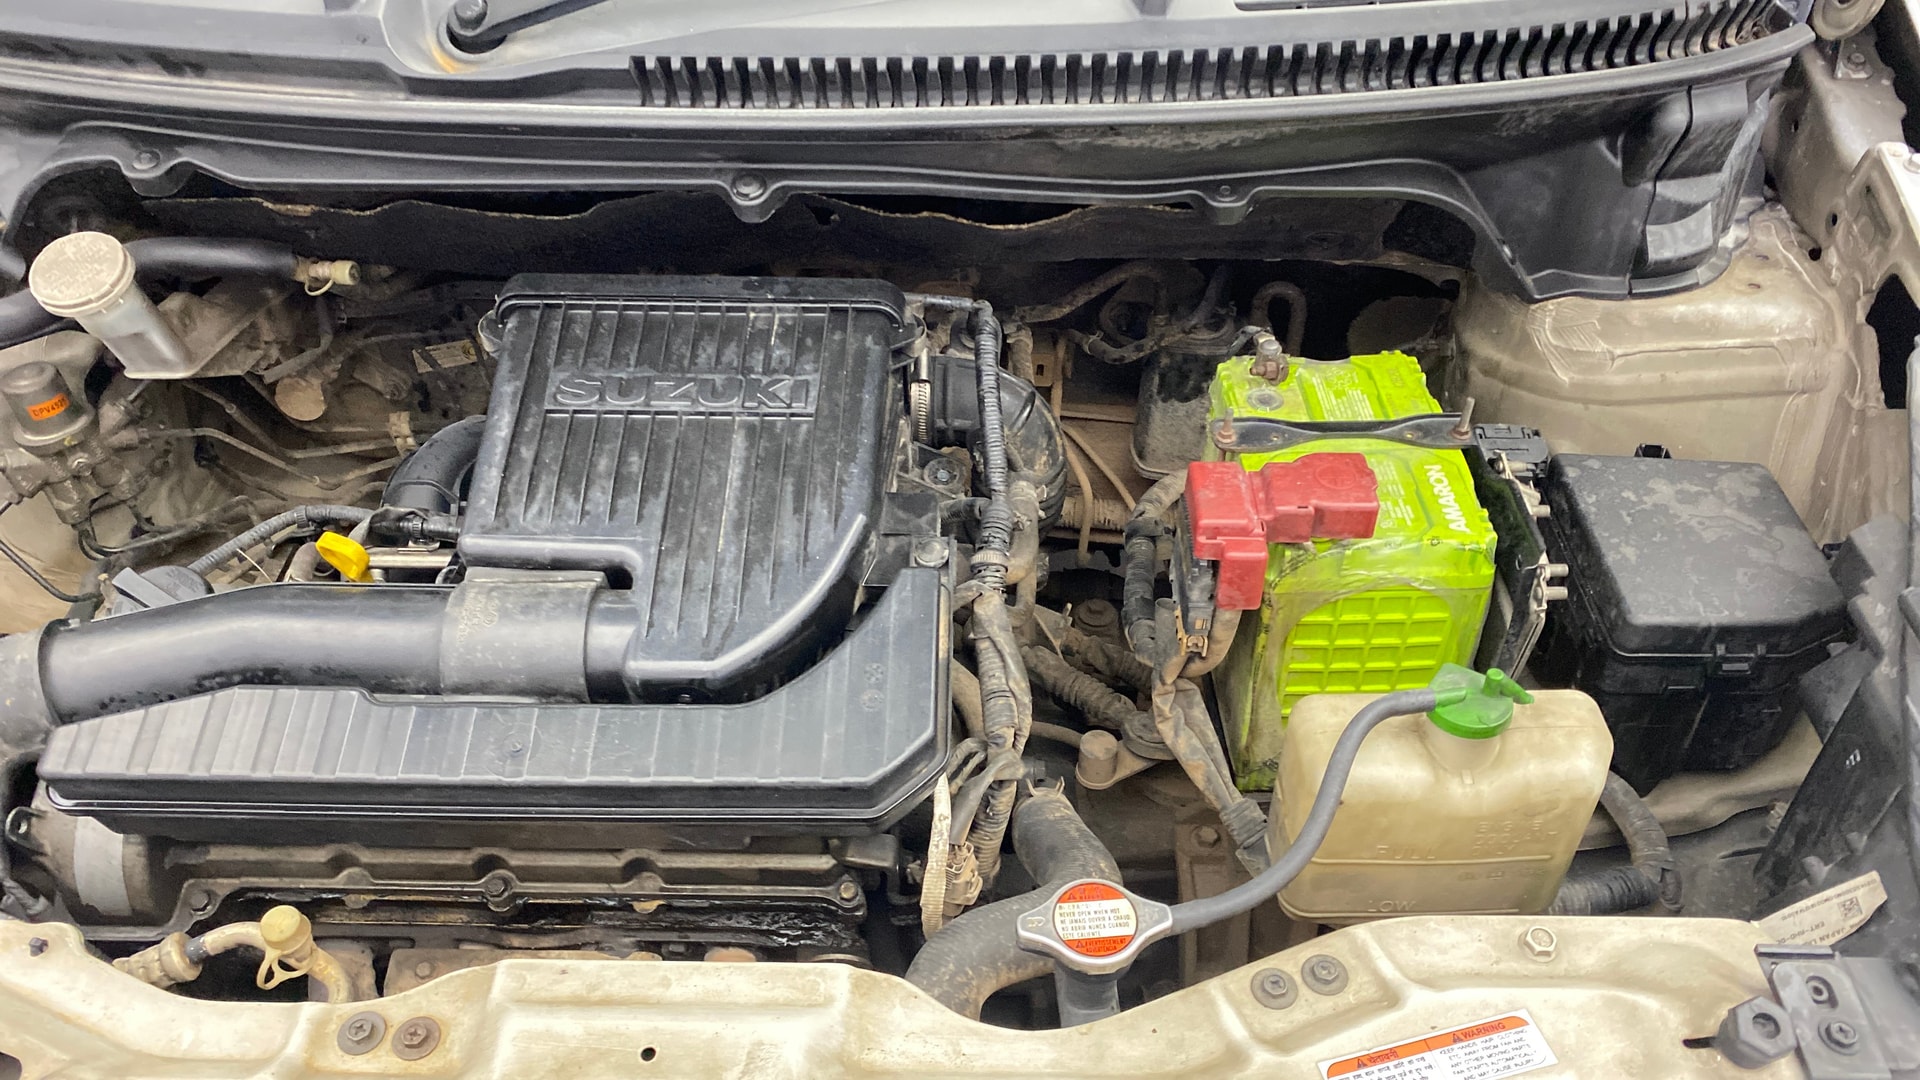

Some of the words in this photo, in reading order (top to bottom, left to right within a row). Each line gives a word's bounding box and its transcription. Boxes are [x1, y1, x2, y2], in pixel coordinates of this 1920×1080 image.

[554, 374, 808, 408] SUZUKI
[1424, 465, 1471, 534] AMARON
[1368, 899, 1416, 912] LOW
[1818, 927, 1846, 943] JAPAN
[1461, 1022, 1506, 1039] WARNING
[1367, 1047, 1399, 1064] चेतावनी
